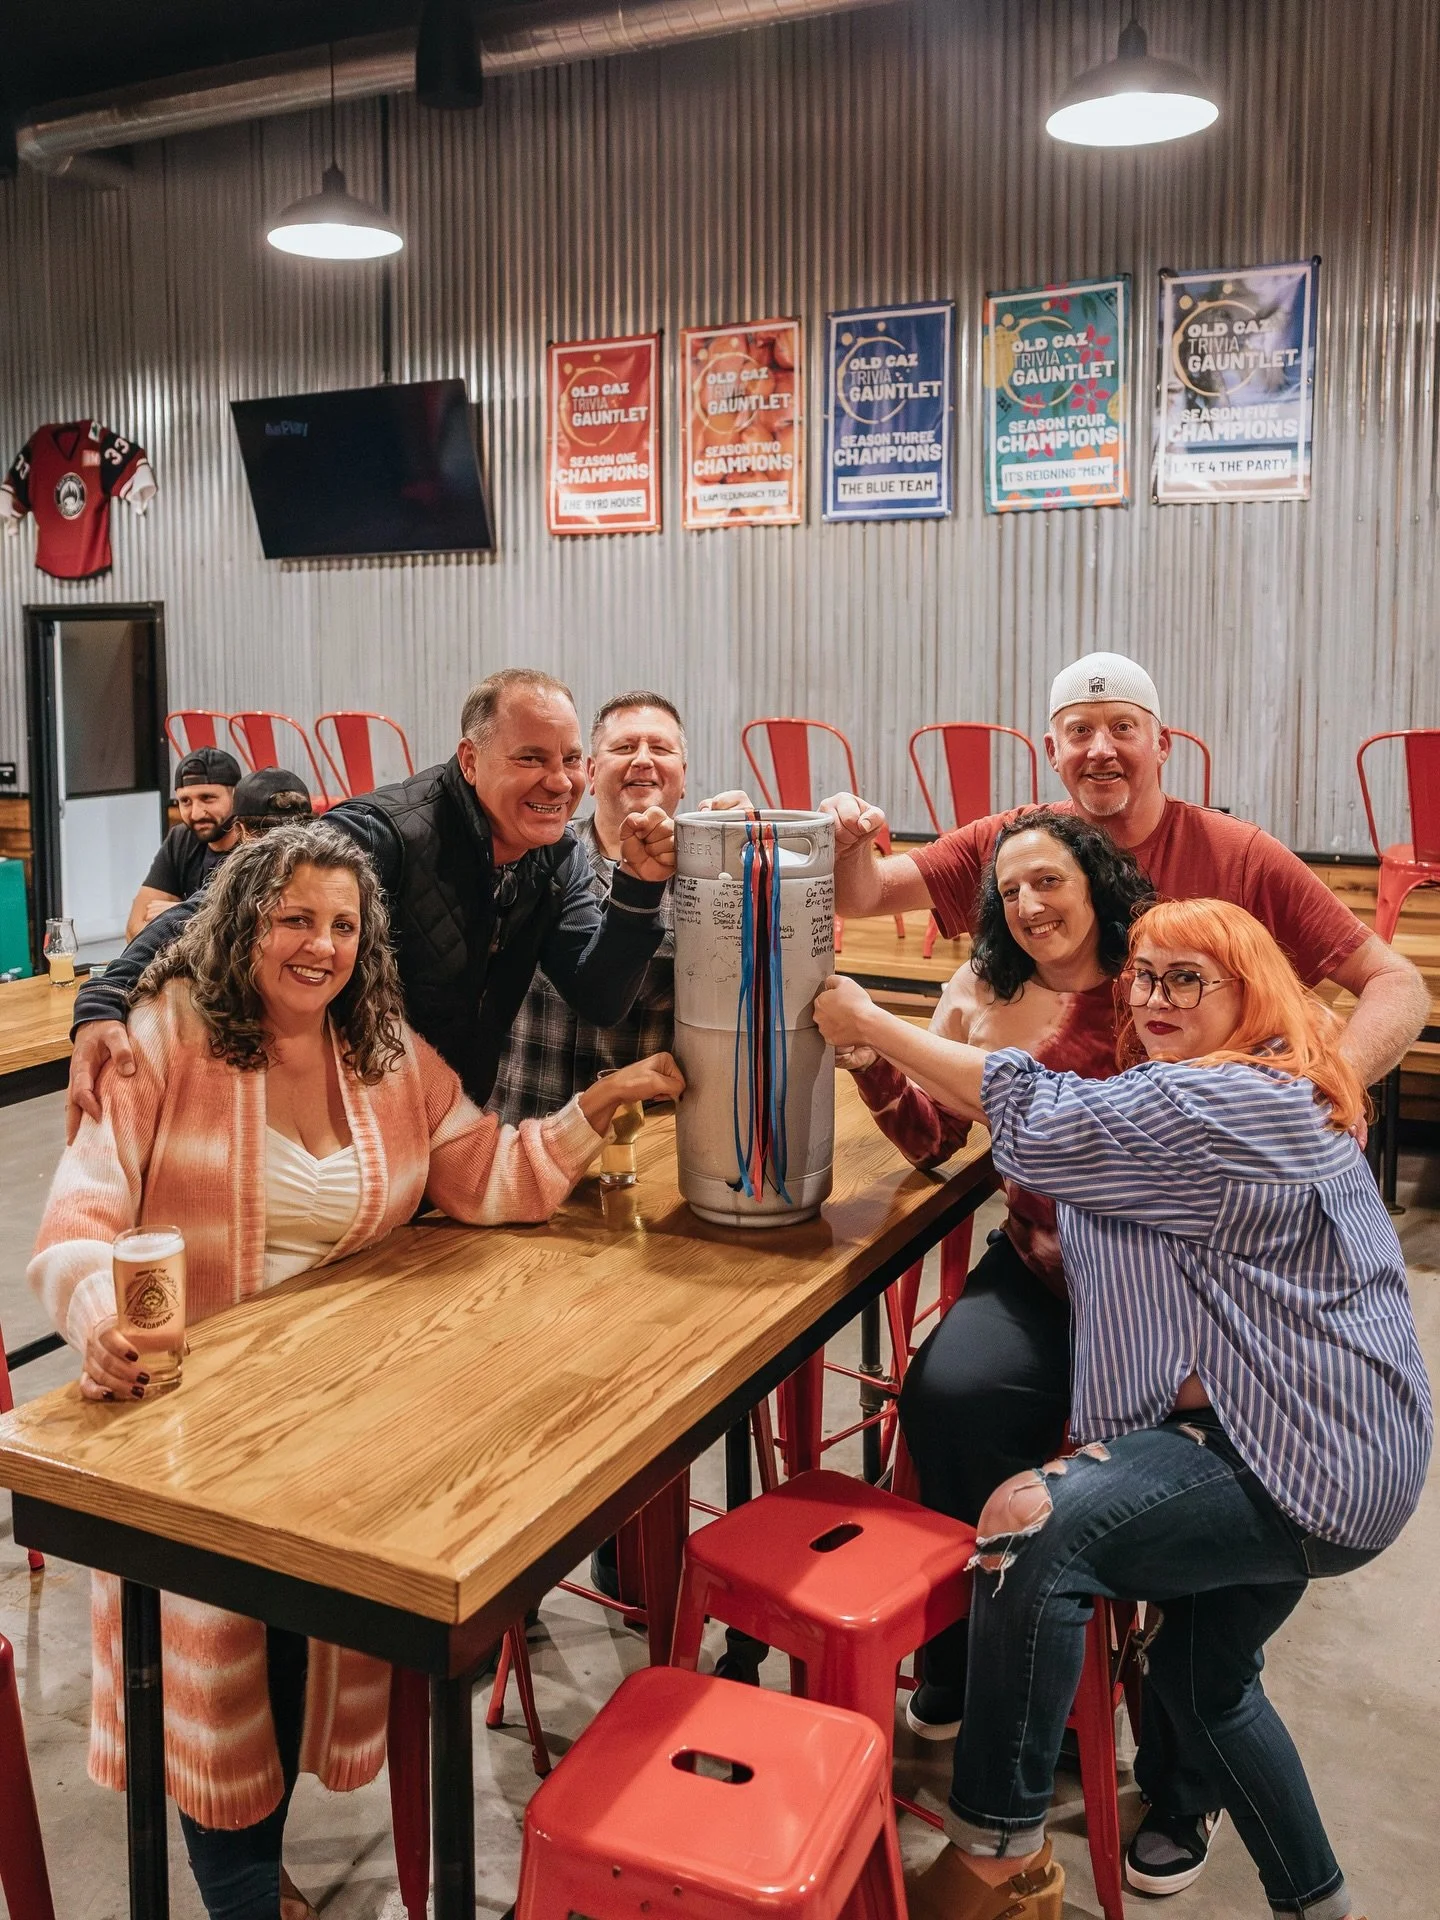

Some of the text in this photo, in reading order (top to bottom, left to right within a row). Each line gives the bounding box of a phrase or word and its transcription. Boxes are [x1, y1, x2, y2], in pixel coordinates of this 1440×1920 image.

[1188, 320, 1272, 337] OLD CAZ
[1012, 332, 1089, 353] OLD CAZ
[1188, 336, 1240, 354] TRIVIA
[850, 357, 882, 370] OLD
[1015, 351, 1059, 369] TRIVIA
[1188, 349, 1298, 372] GAUNTLET
[706, 372, 736, 385] OLD
[851, 370, 892, 385] TRIVIA
[1013, 360, 1115, 386] GAUNTLET
[571, 385, 598, 397] OLD
[849, 381, 942, 402] GAUNTLET
[573, 397, 608, 411] TRIVIA
[708, 393, 791, 415] GAUNTLET
[1181, 404, 1279, 421] SEASON FIVE
[572, 406, 648, 426] GAUNTLET
[1009, 414, 1106, 434] SEASON FOUR
[841, 431, 935, 448] SEASON THREE
[997, 426, 1118, 453] CHAMPIONS
[1168, 420, 1298, 442] CHAMPIONS
[104, 438, 130, 465] 33
[705, 441, 781, 457] SEASON TWO
[834, 444, 942, 467] CHAMPIONS
[570, 452, 637, 468] SEASON ONE
[694, 453, 793, 476] CHAMPIONS
[1208, 461, 1216, 472] 4
[1219, 460, 1243, 472] THE
[1247, 459, 1287, 471] PARTY
[558, 464, 649, 484] CHAMPIONS
[1004, 471, 1023, 483] IT'S
[1026, 468, 1076, 481] REIGNING
[841, 479, 933, 495] THE BLUE TEAM
[610, 496, 642, 508] HOUSE
[684, 843, 711, 855] BEER
